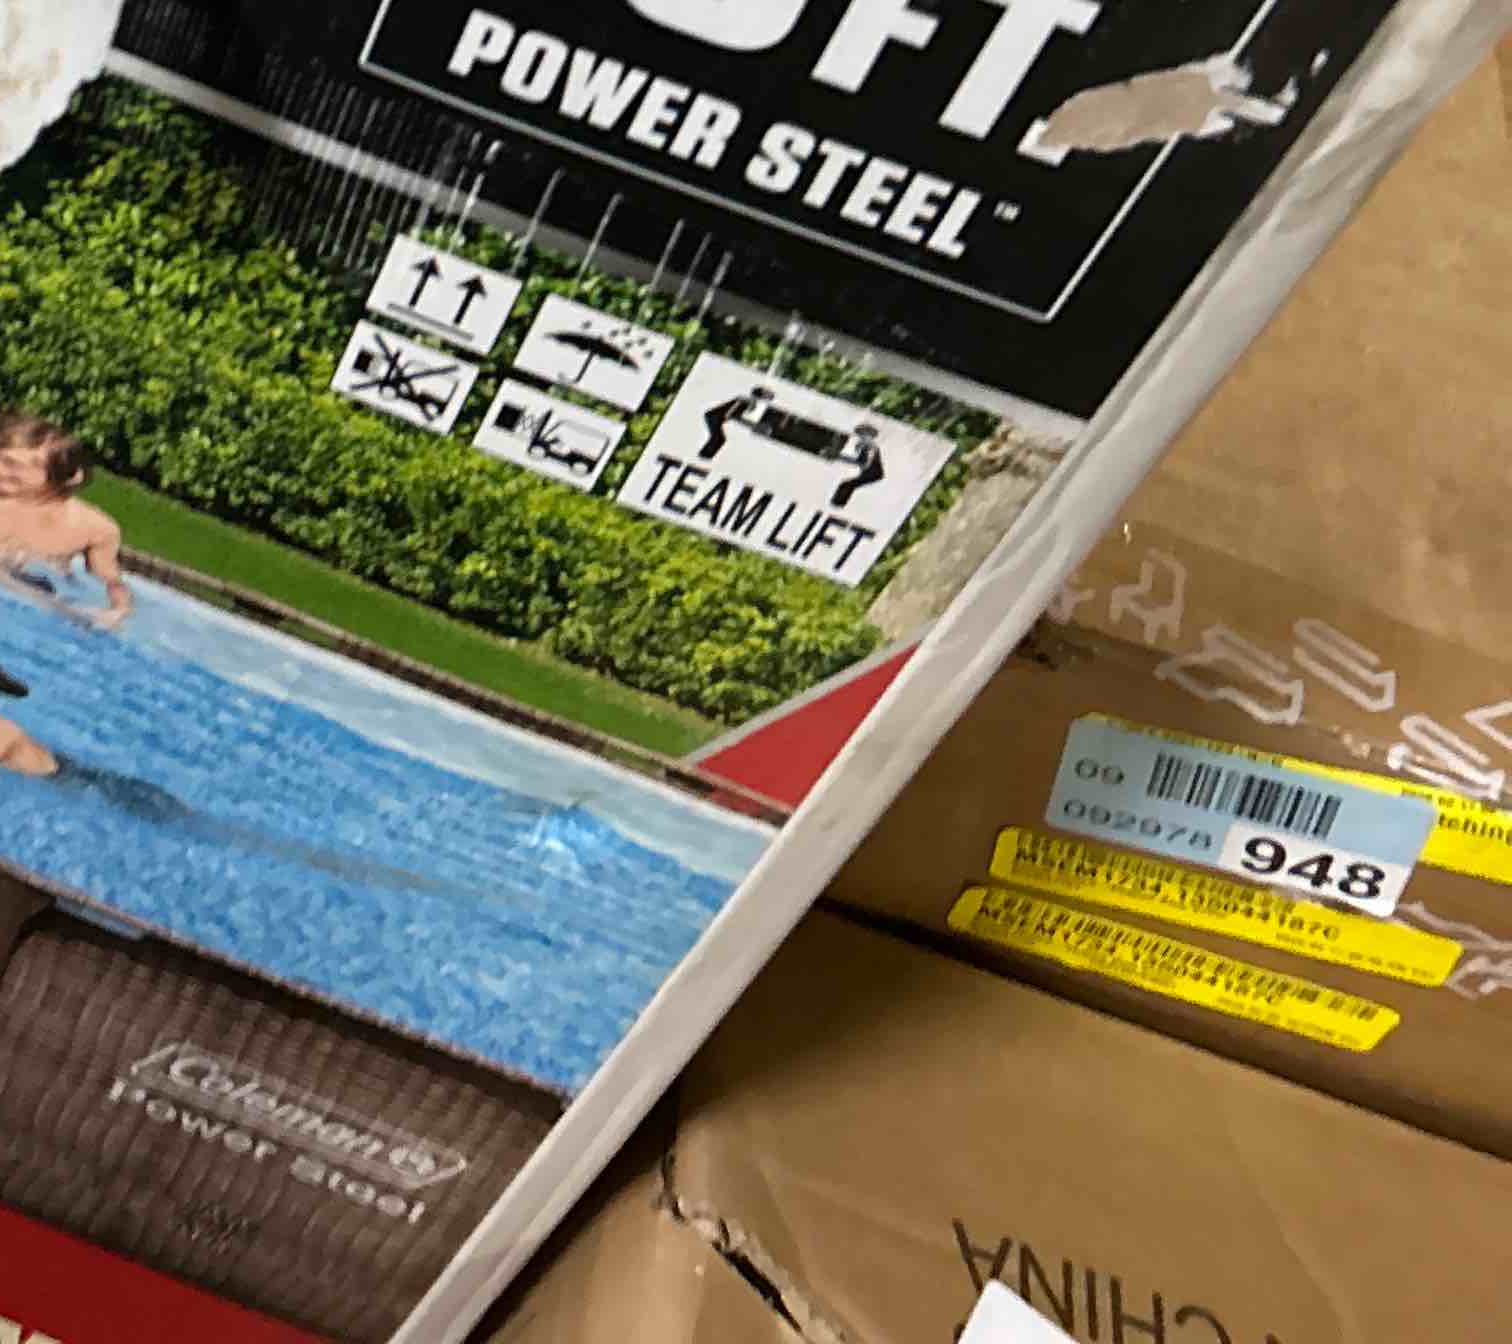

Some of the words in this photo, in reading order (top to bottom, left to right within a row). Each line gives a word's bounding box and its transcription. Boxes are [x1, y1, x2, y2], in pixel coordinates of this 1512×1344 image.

[446, 8, 742, 169] POWER
[644, 454, 774, 537] TEAM
[766, 502, 876, 570] LIFT
[1240, 836, 1385, 899] 948
[109, 1079, 278, 1161] Power
[290, 1154, 426, 1224] Steel
[169, 1055, 385, 1160] Coleman
